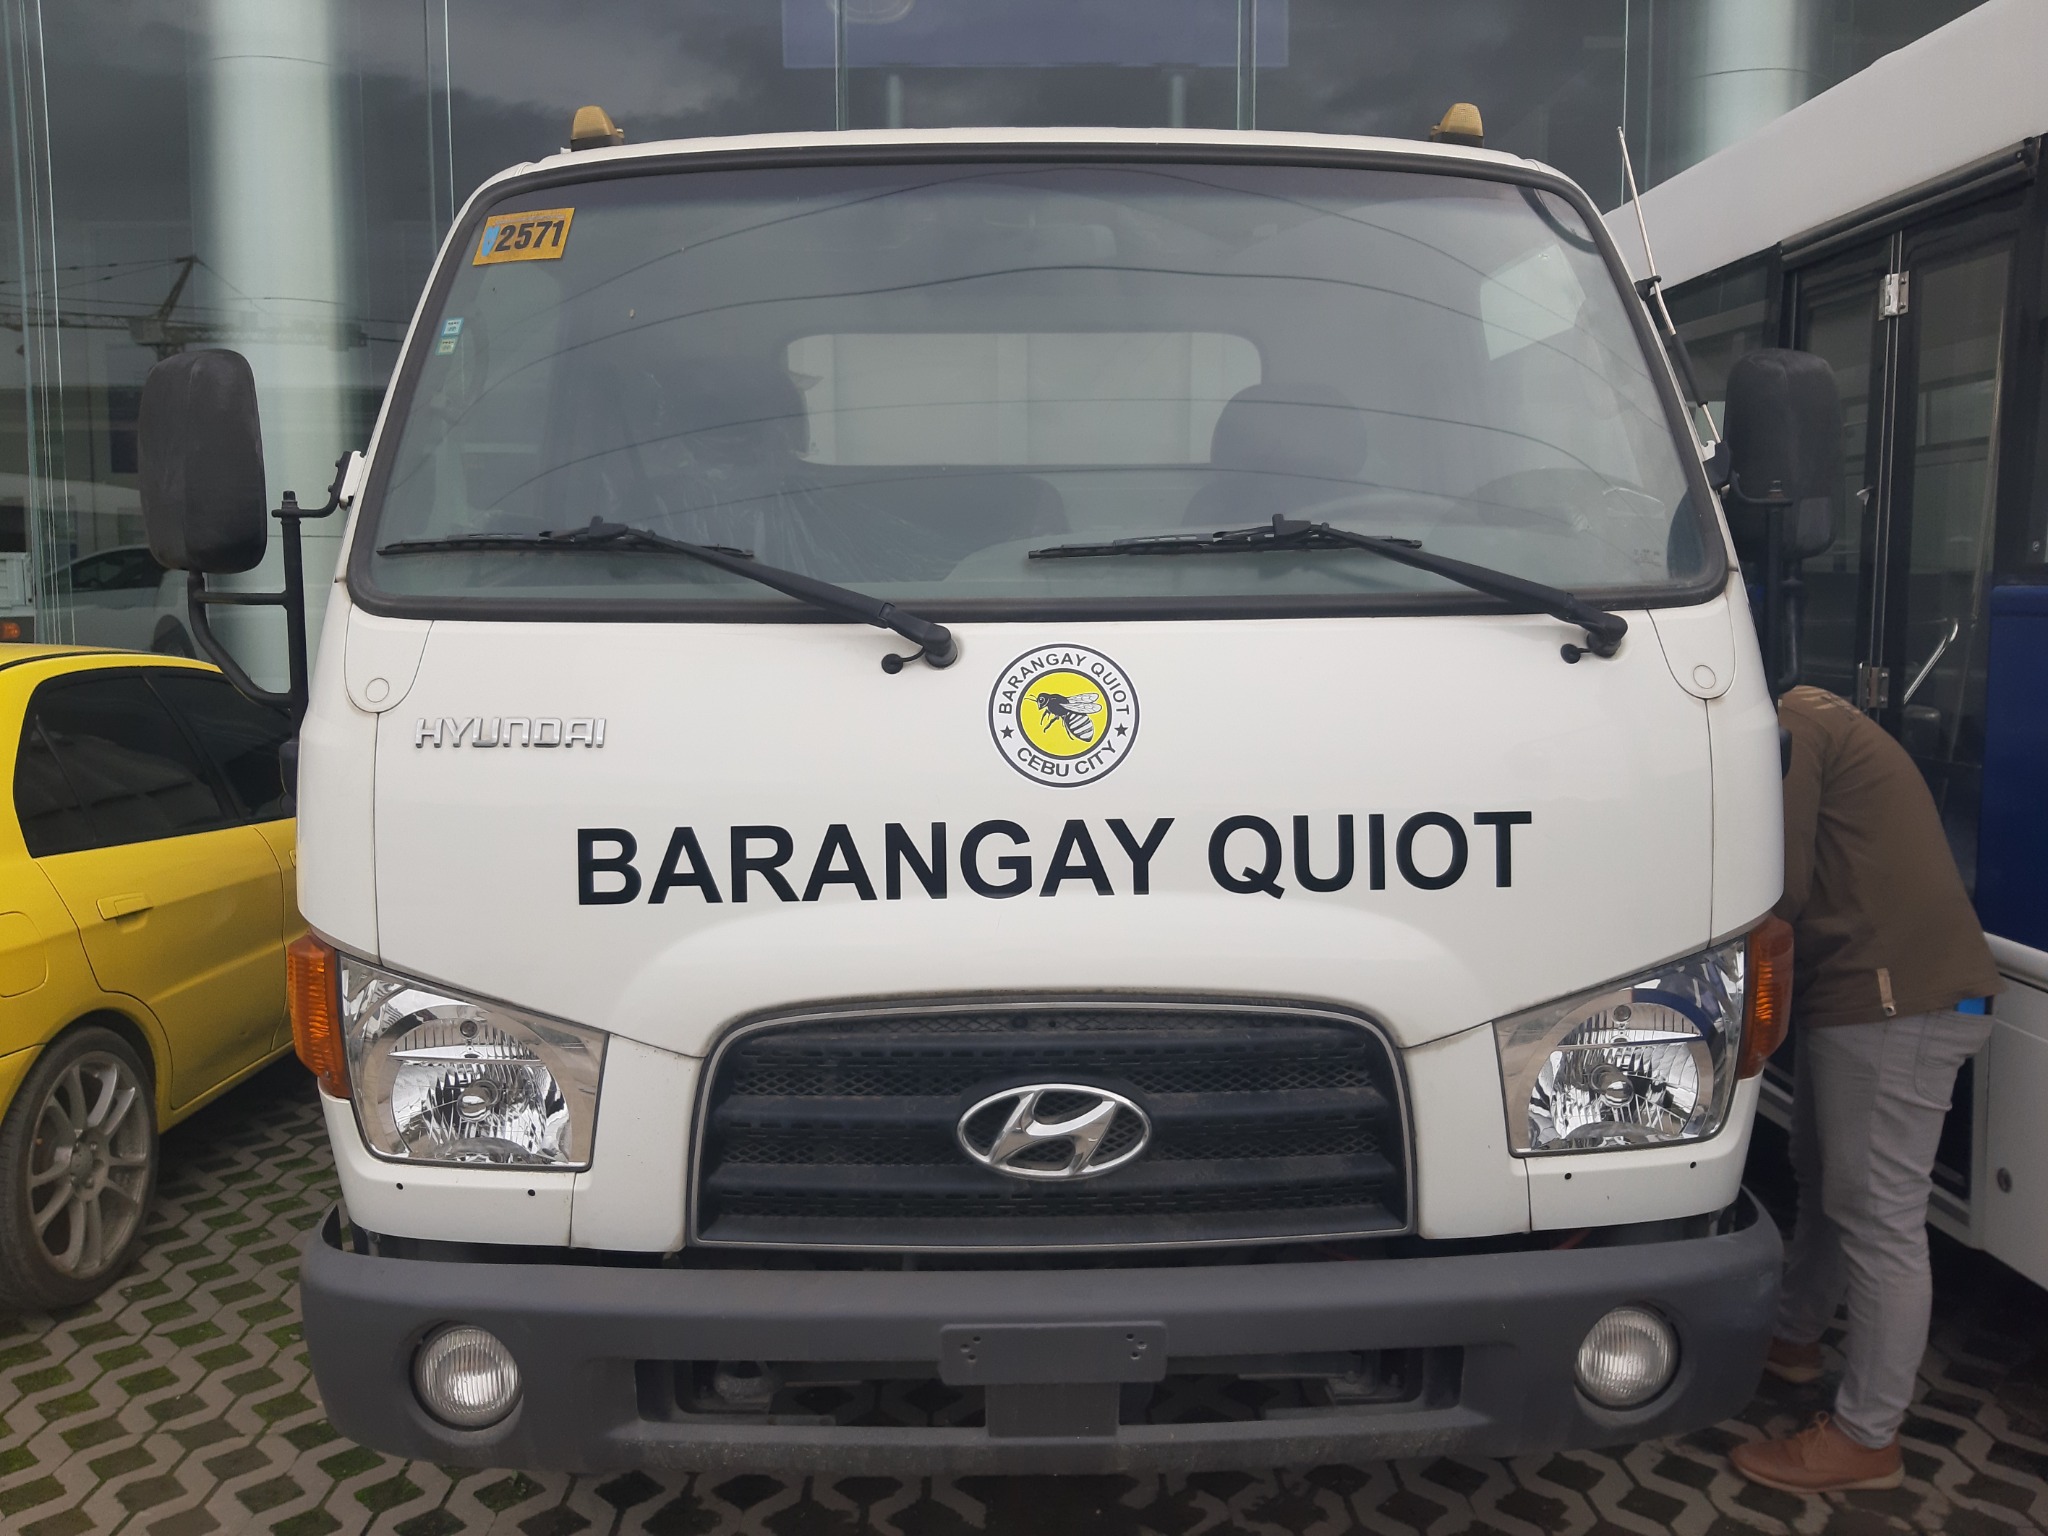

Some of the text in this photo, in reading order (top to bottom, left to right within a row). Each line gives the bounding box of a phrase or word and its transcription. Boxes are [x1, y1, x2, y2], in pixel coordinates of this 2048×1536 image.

[495, 220, 564, 252] 2571
[998, 653, 1130, 716] BARANGAY QUIOT
[415, 717, 606, 748] HYUNDAI
[1017, 739, 1117, 777] CEBU CITY
[577, 811, 1532, 905] BARANGAY QUIOT
